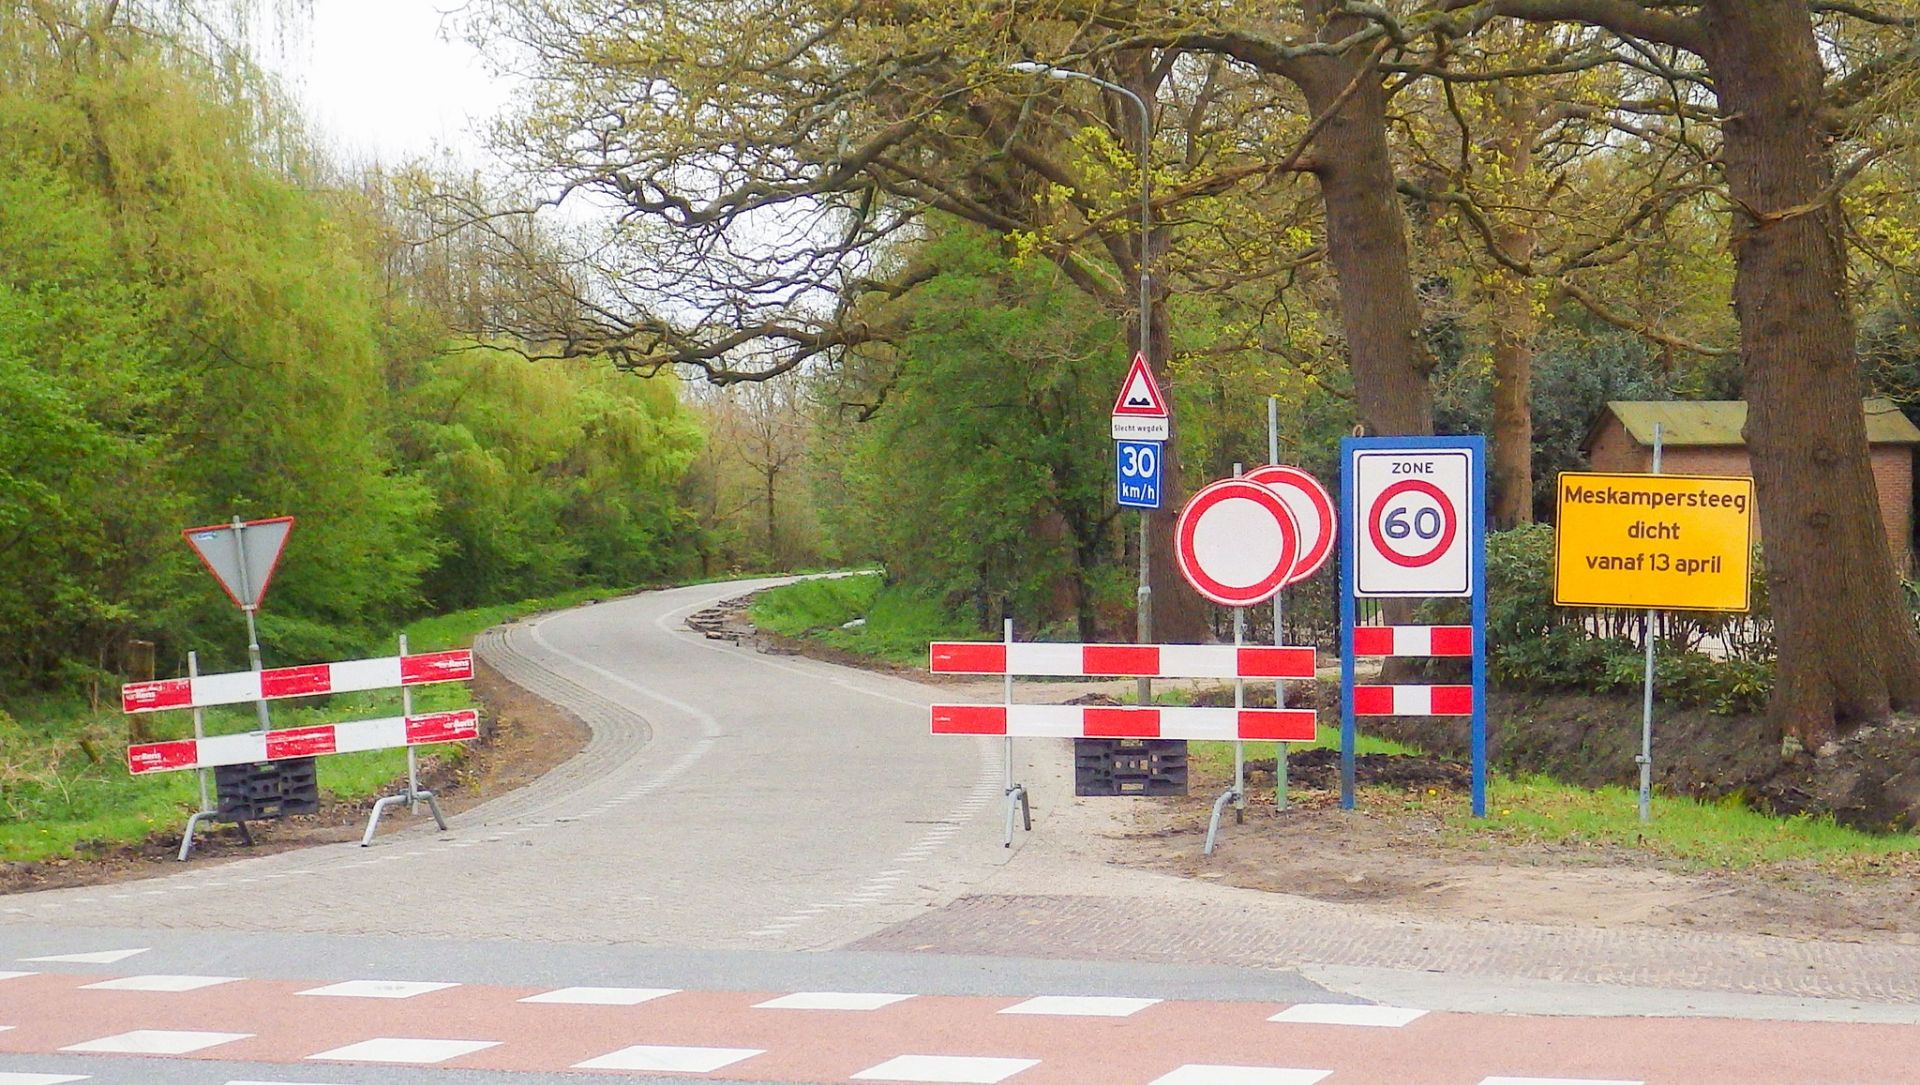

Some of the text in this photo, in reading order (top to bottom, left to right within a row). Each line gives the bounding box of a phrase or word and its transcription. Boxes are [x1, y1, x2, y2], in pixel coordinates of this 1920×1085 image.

[1114, 424, 1164, 433] Slecht wegdek
[1121, 446, 1156, 478] 30
[1391, 462, 1435, 474] ZONE
[1122, 482, 1156, 501] km/h
[1565, 485, 1747, 514] Meskampersteeg
[1384, 506, 1441, 540] 60
[1627, 520, 1681, 540] dicht
[1585, 553, 1721, 576] vanaf 13 april
